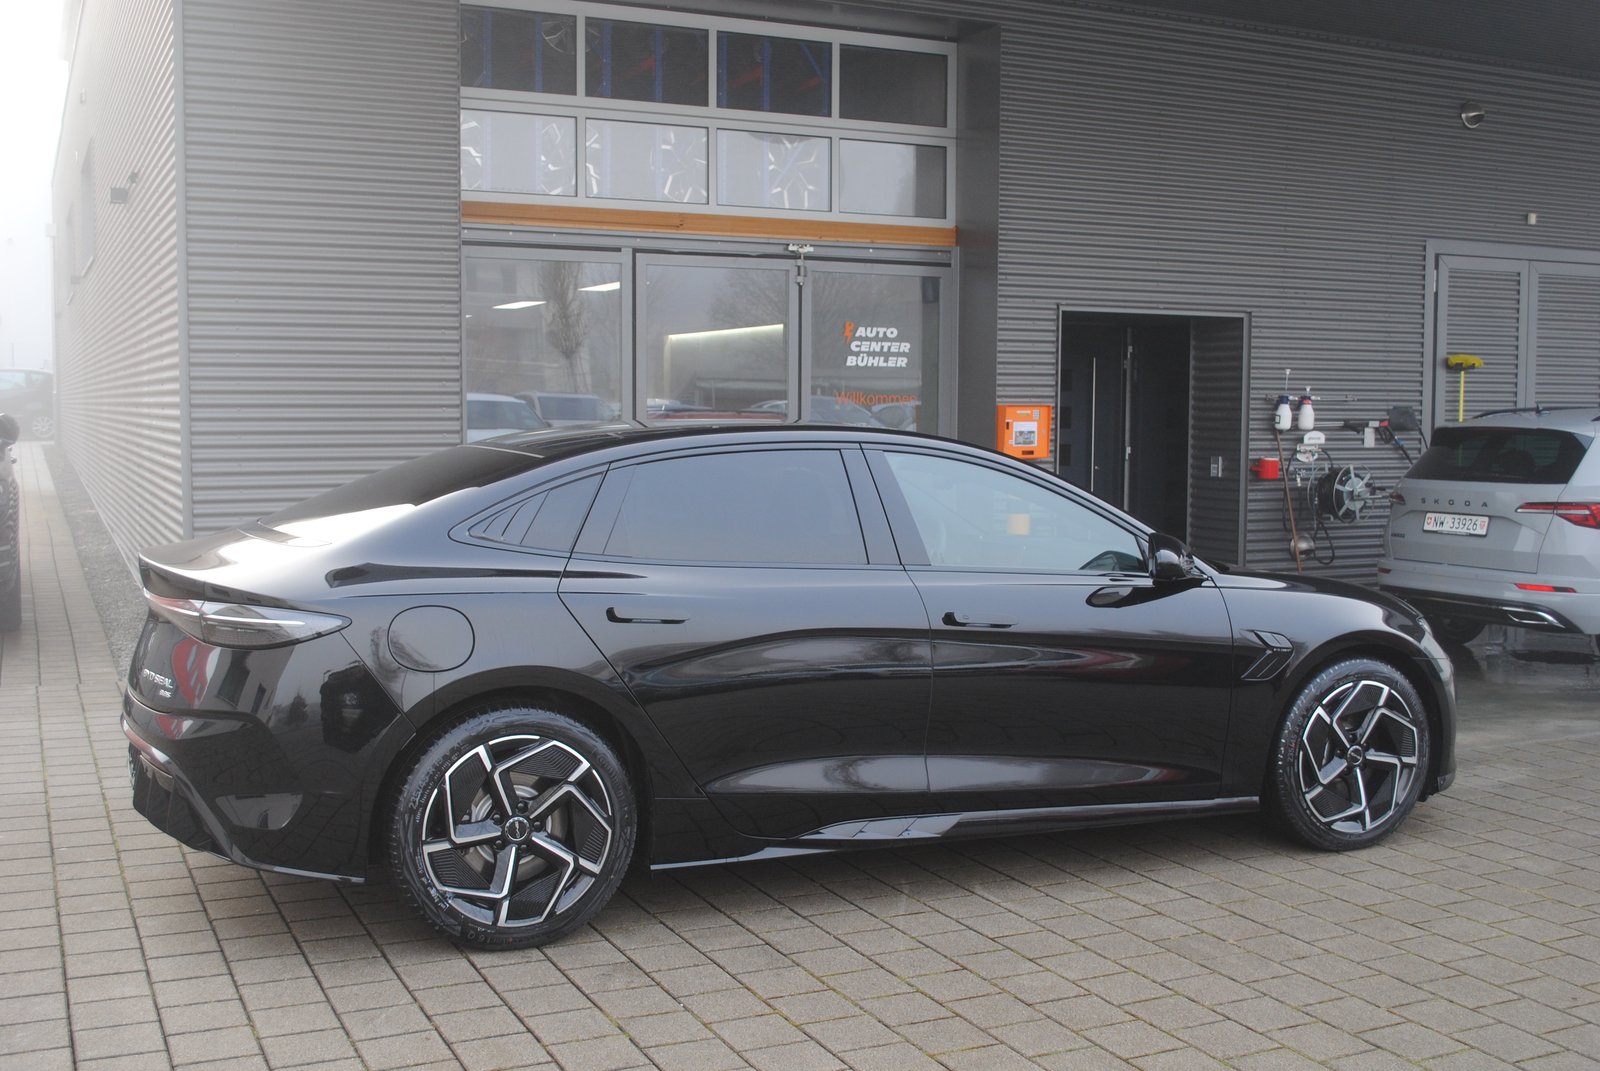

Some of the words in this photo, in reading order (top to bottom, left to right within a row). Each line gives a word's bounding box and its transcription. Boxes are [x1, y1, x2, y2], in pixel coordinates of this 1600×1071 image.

[855, 326, 898, 338] AUTO
[850, 340, 911, 353] CENTER
[846, 353, 908, 367] BÜHLER
[1449, 517, 1478, 531] 33926
[154, 673, 173, 689] SEAL
